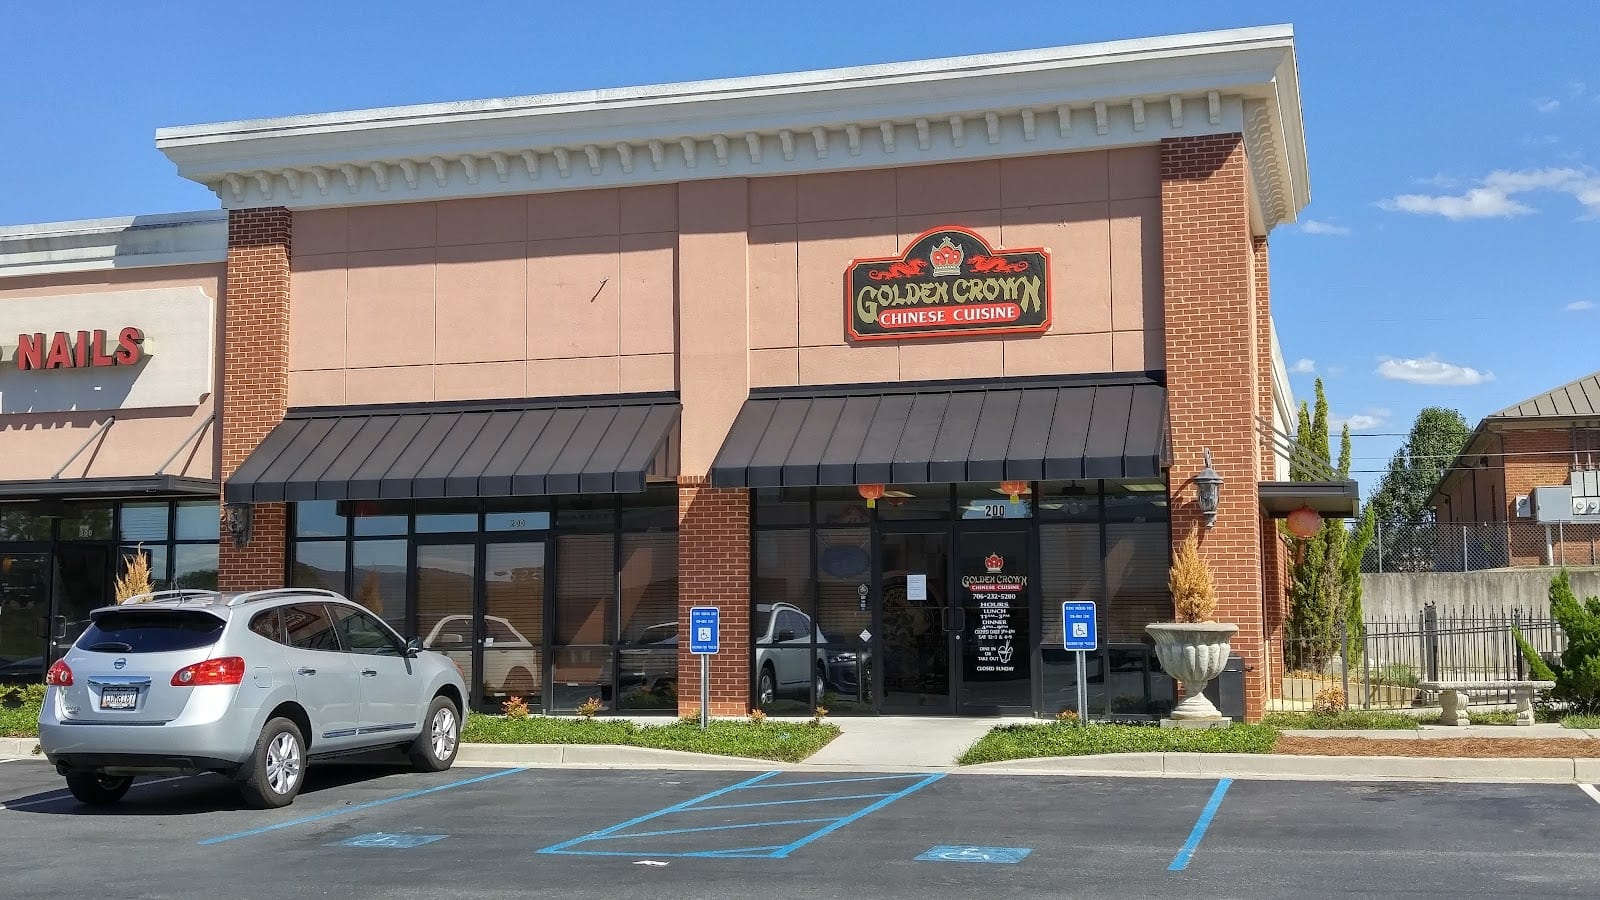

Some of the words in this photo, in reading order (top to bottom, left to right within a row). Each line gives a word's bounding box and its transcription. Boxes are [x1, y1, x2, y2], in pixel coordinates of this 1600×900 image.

[856, 281, 948, 323] GOLDEN
[952, 275, 1041, 313] CROWN
[880, 310, 946, 326] CHINESE
[953, 305, 1016, 322] CUISINE
[18, 326, 145, 371] NAILS
[985, 505, 1005, 517] 200
[961, 575, 996, 588] GOLDEN
[996, 574, 1028, 586] CROWN
